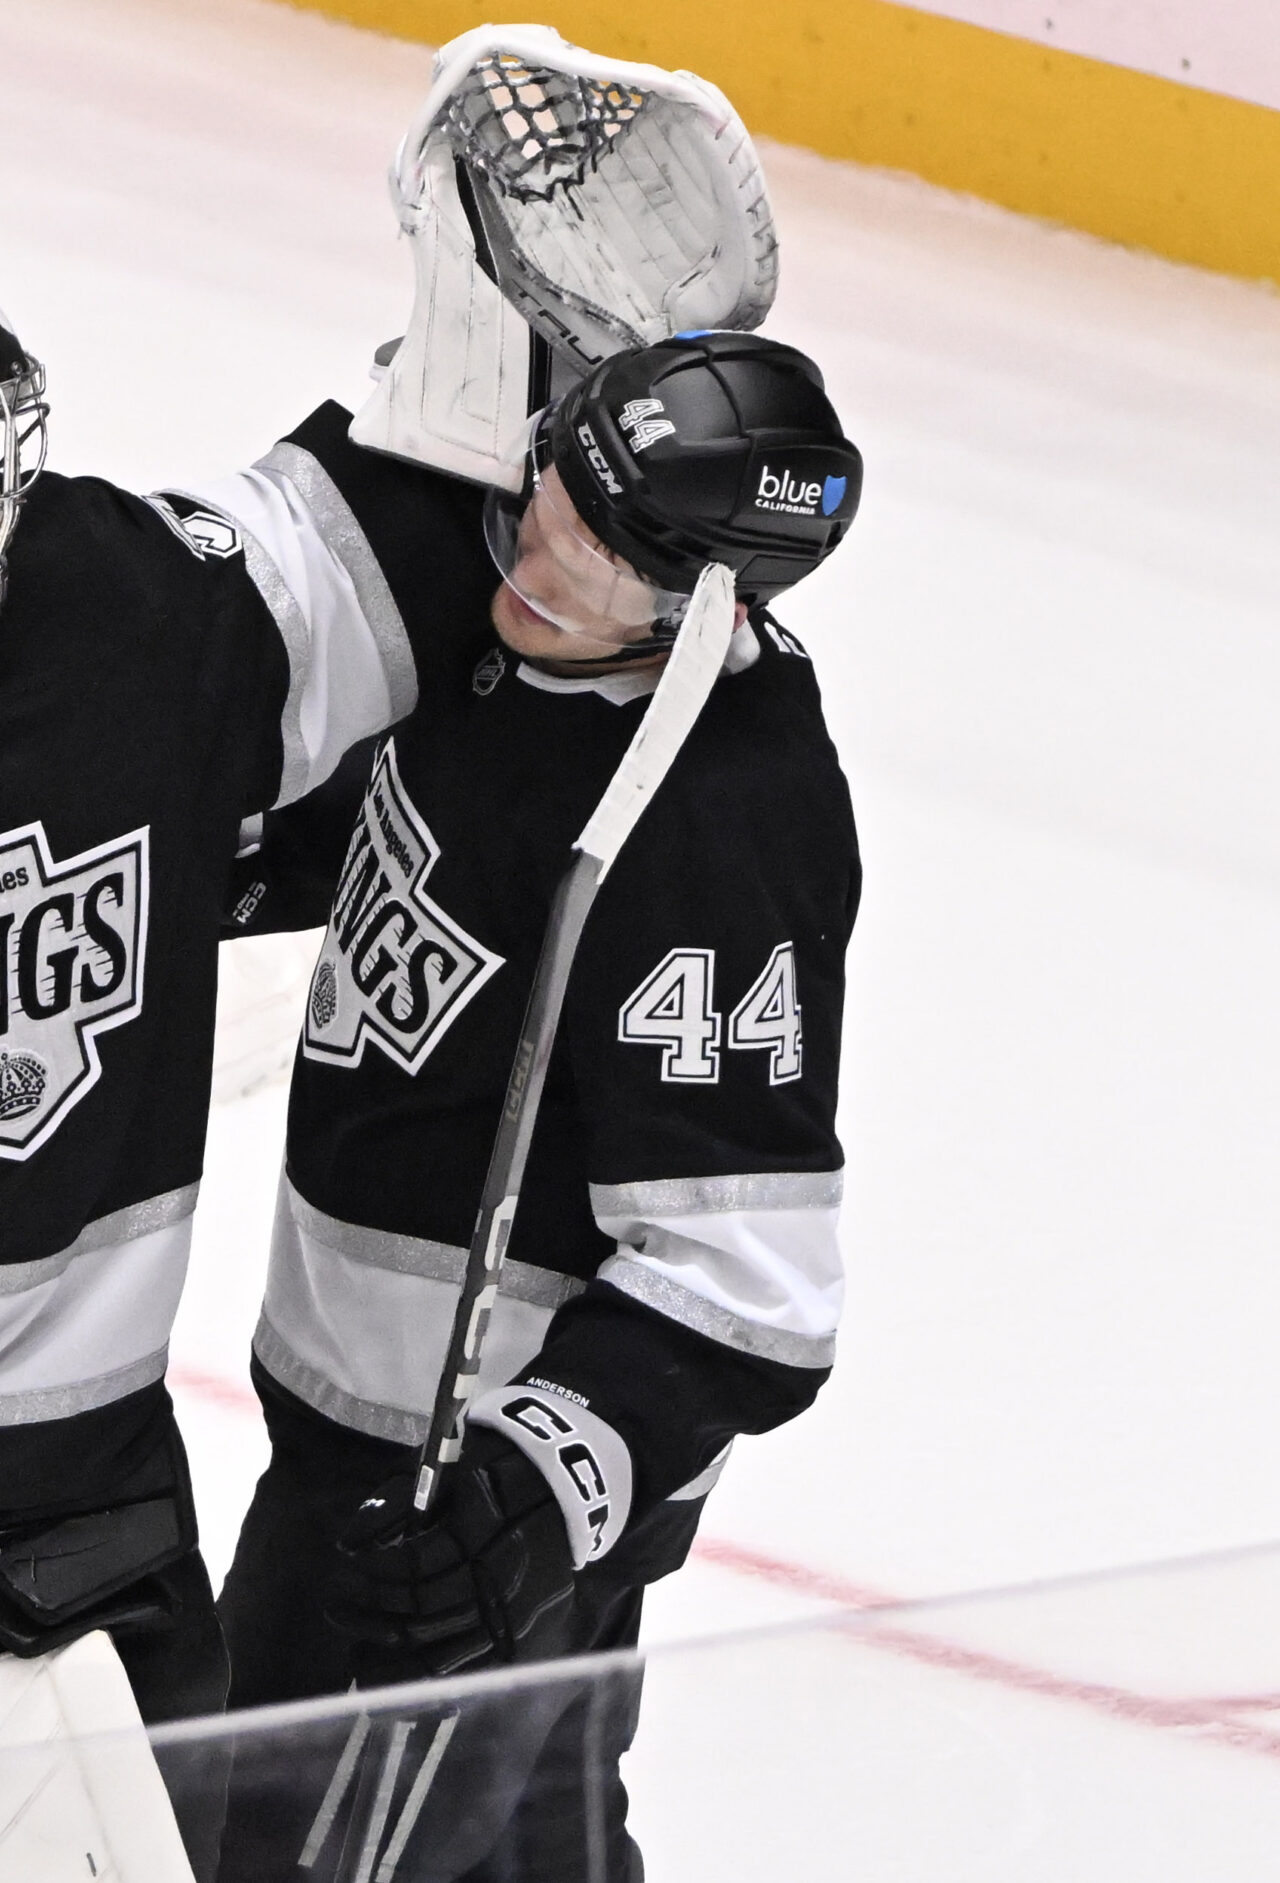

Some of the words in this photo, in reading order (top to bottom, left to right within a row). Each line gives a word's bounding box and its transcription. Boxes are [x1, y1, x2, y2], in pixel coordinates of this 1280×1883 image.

[511, 278, 604, 365] TRU
[618, 398, 676, 453] 44
[578, 421, 624, 494] CCM
[758, 465, 822, 505] blue
[754, 498, 816, 515] CALIFORNIA
[237, 882, 267, 923] CCM
[333, 815, 458, 1034] INGS
[618, 941, 802, 1086] 44
[526, 1376, 590, 1408] ANDERSON
